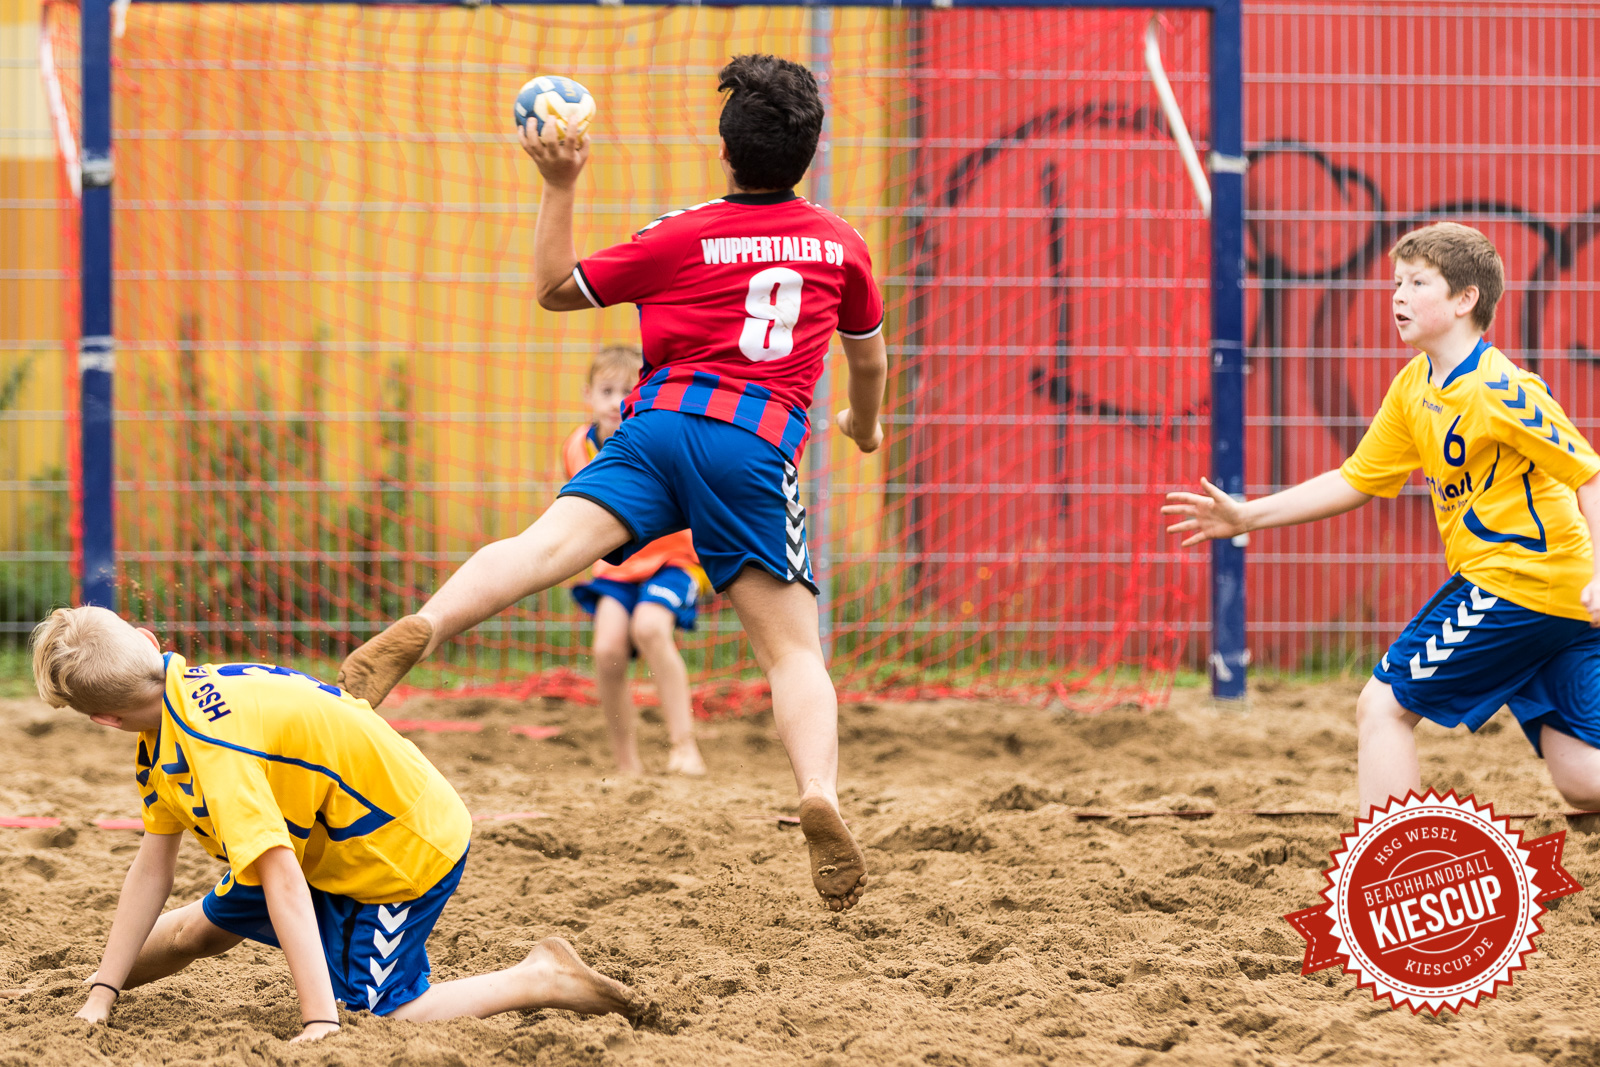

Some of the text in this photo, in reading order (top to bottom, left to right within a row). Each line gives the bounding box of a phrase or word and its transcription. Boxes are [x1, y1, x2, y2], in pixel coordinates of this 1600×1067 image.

[701, 236, 844, 267] WUPPERTALER SV
[738, 267, 804, 362] 9
[1443, 415, 1466, 467] 6
[191, 682, 232, 723] HSG
